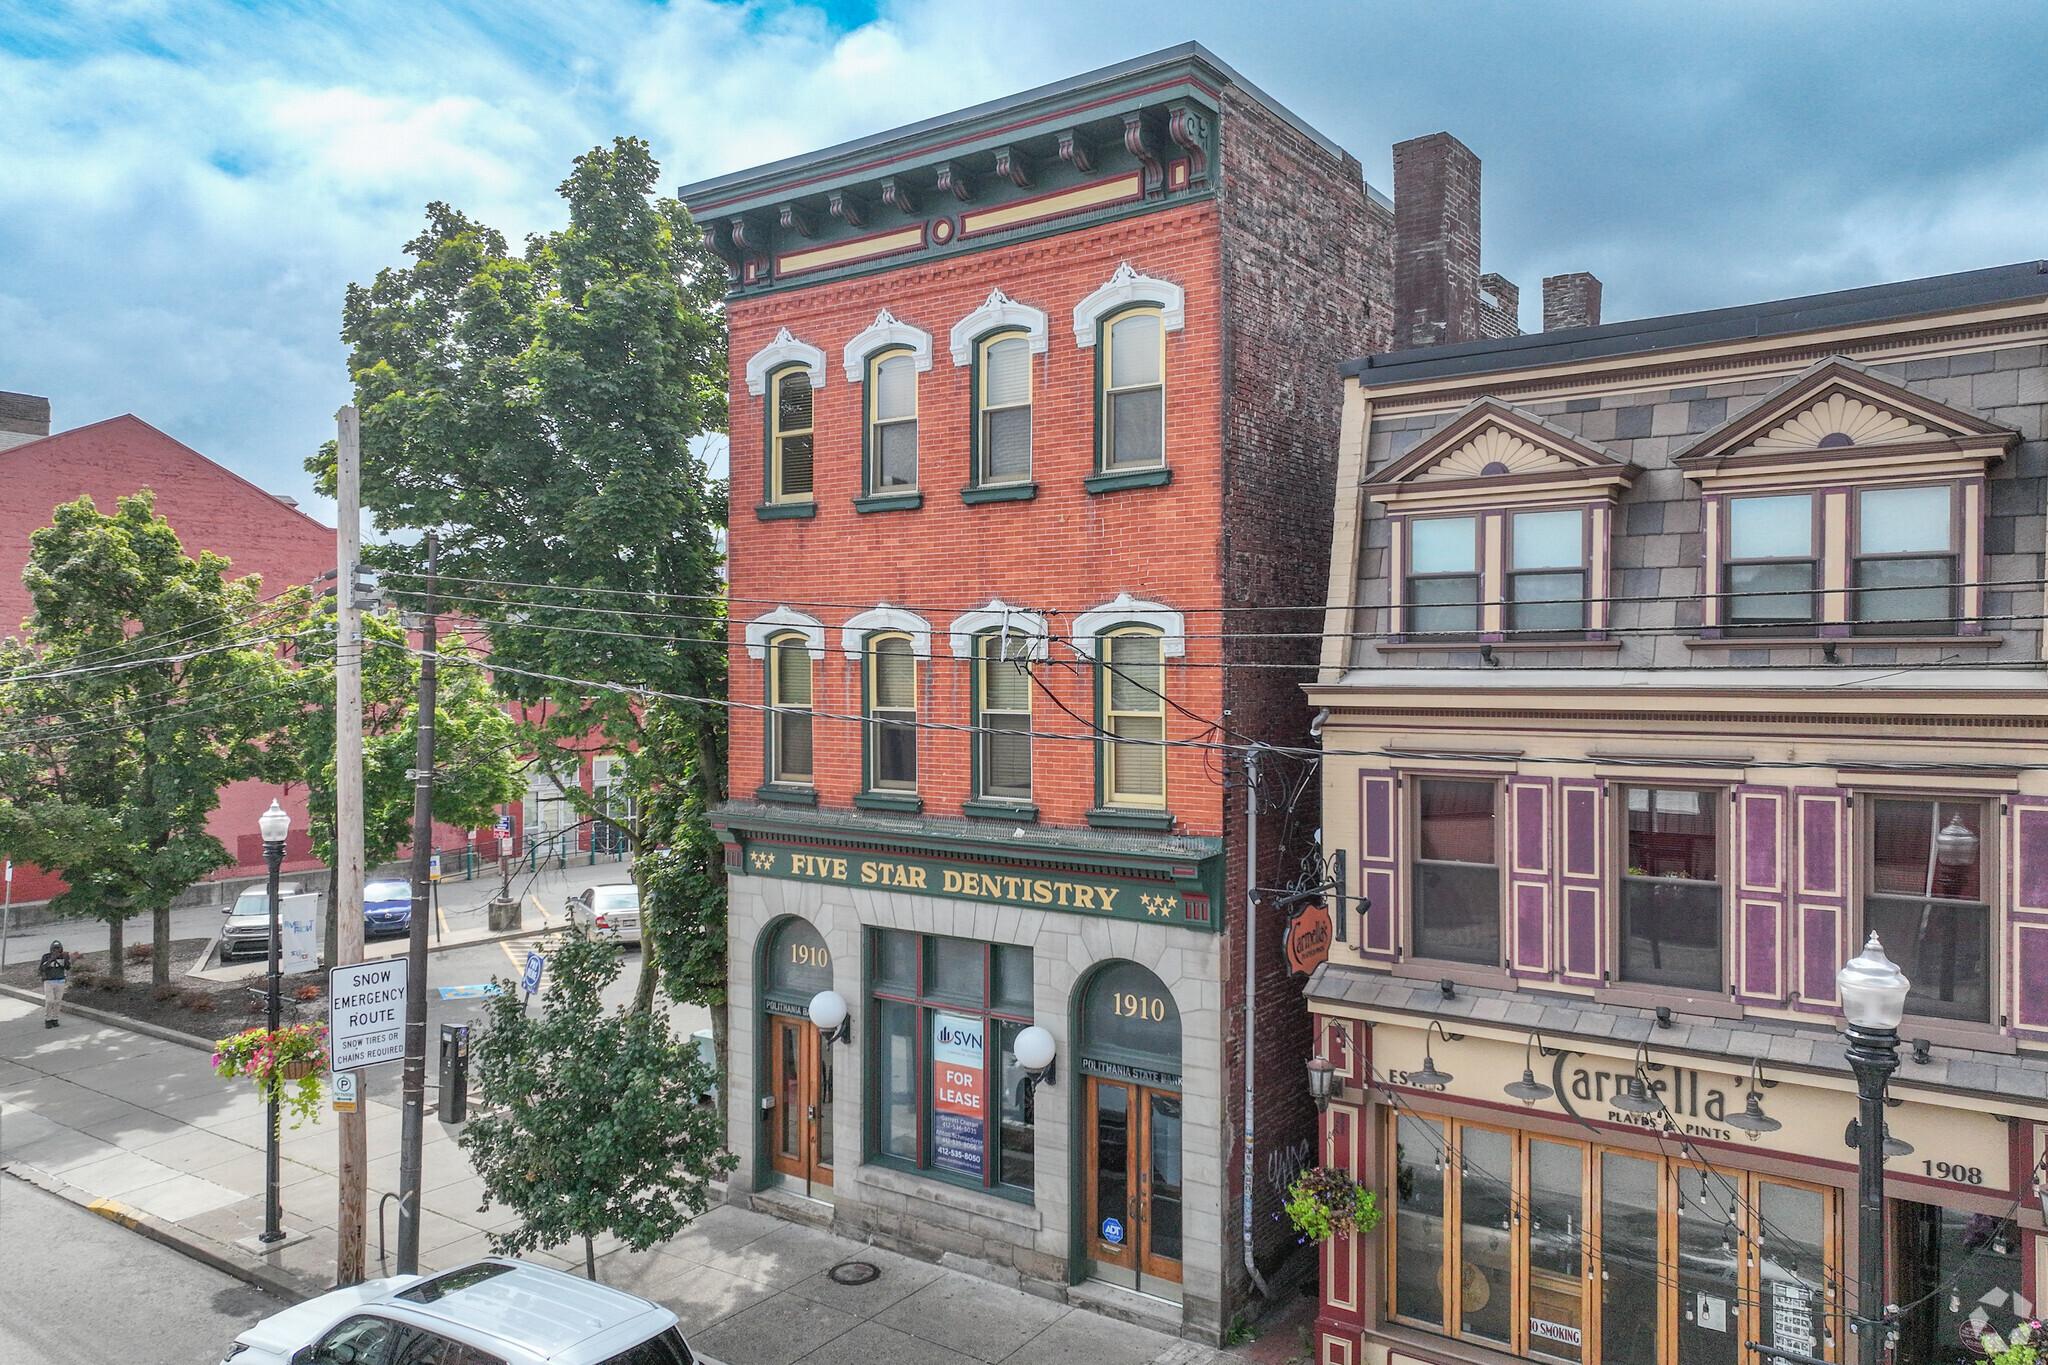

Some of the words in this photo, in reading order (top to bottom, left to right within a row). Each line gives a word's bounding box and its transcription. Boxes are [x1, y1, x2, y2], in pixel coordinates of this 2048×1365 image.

[791, 854, 848, 880] FIVE
[861, 861, 927, 888] STAR
[943, 870, 1119, 911] DENTISTRY
[791, 944, 828, 968] 1910
[353, 971, 391, 987] SNOW
[334, 987, 405, 1010] EMERGENCY
[766, 1001, 802, 1015] POLITHANIA
[1114, 993, 1165, 1021] 1910
[350, 1009, 395, 1027] ROUTE
[342, 1038, 363, 1050] SNOW
[366, 1035, 386, 1045] TIRES
[388, 1032, 399, 1041] OR
[954, 1030, 982, 1049] SVN
[337, 1051, 365, 1065] CHAINS
[367, 1045, 404, 1059] REQUIRED
[946, 1070, 973, 1088] FOR
[1083, 1059, 1131, 1077] POLITHANIA
[1132, 1069, 1159, 1083] STATE
[341, 1080, 349, 1089] P
[939, 1087, 980, 1108] LEASE
[1686, 1123, 1730, 1141] PINTS
[1922, 1159, 1982, 1185] 1908
[1105, 1225, 1120, 1236] ADT
[1540, 1323, 1579, 1344] SMOKING
